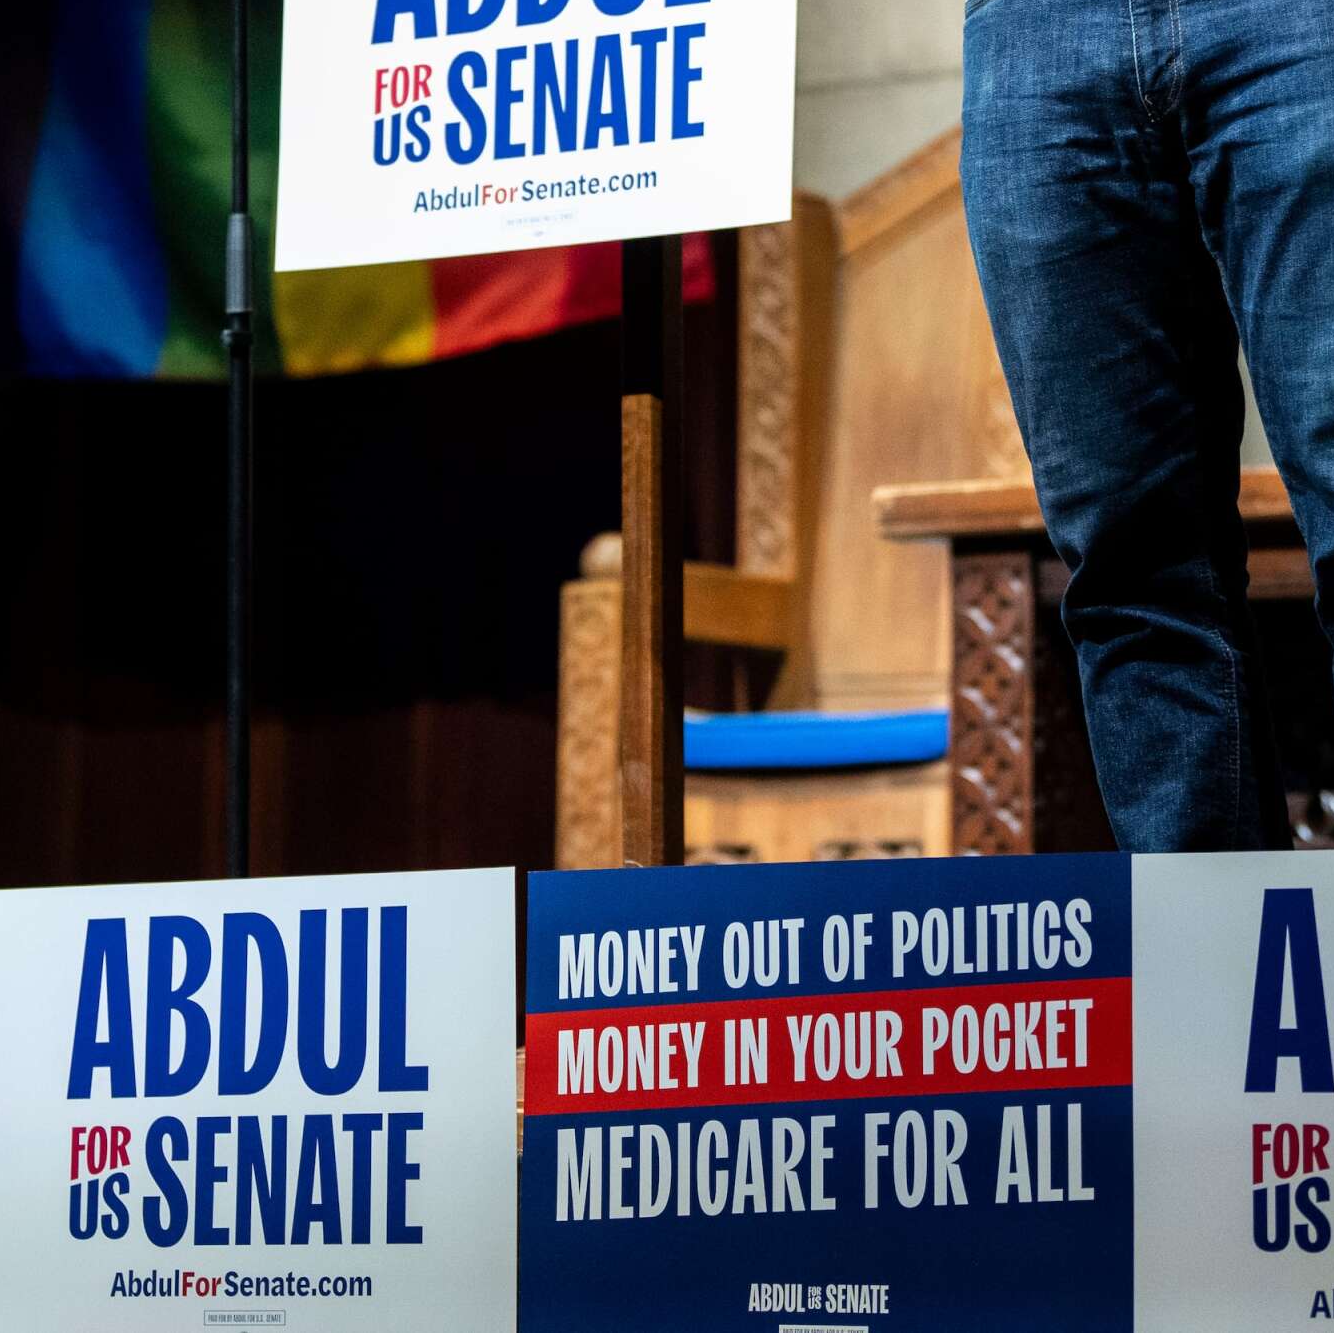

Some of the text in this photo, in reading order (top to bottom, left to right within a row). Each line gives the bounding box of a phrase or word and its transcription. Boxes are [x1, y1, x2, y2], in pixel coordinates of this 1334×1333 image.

[373, 22, 706, 166] US SENATE
[374, 64, 432, 114] FOR
[413, 170, 658, 213] AbdulForSenate.com
[559, 898, 1092, 999] MONEY OUT OF POLITICS
[66, 905, 428, 1100] ABDUL
[557, 998, 1093, 1095] MONEY IN YOUR POCKET
[68, 1111, 423, 1248] US SENATE
[70, 1125, 131, 1181] FOR
[556, 1103, 1095, 1221] MEDICARE FOR ALL
[1252, 1122, 1331, 1185] FOR
[1252, 1176, 1331, 1253] US
[110, 1269, 373, 1302] AbdulForSenate.com
[748, 1283, 889, 1314] ABDUL SENATE
[808, 1297, 822, 1310] US
